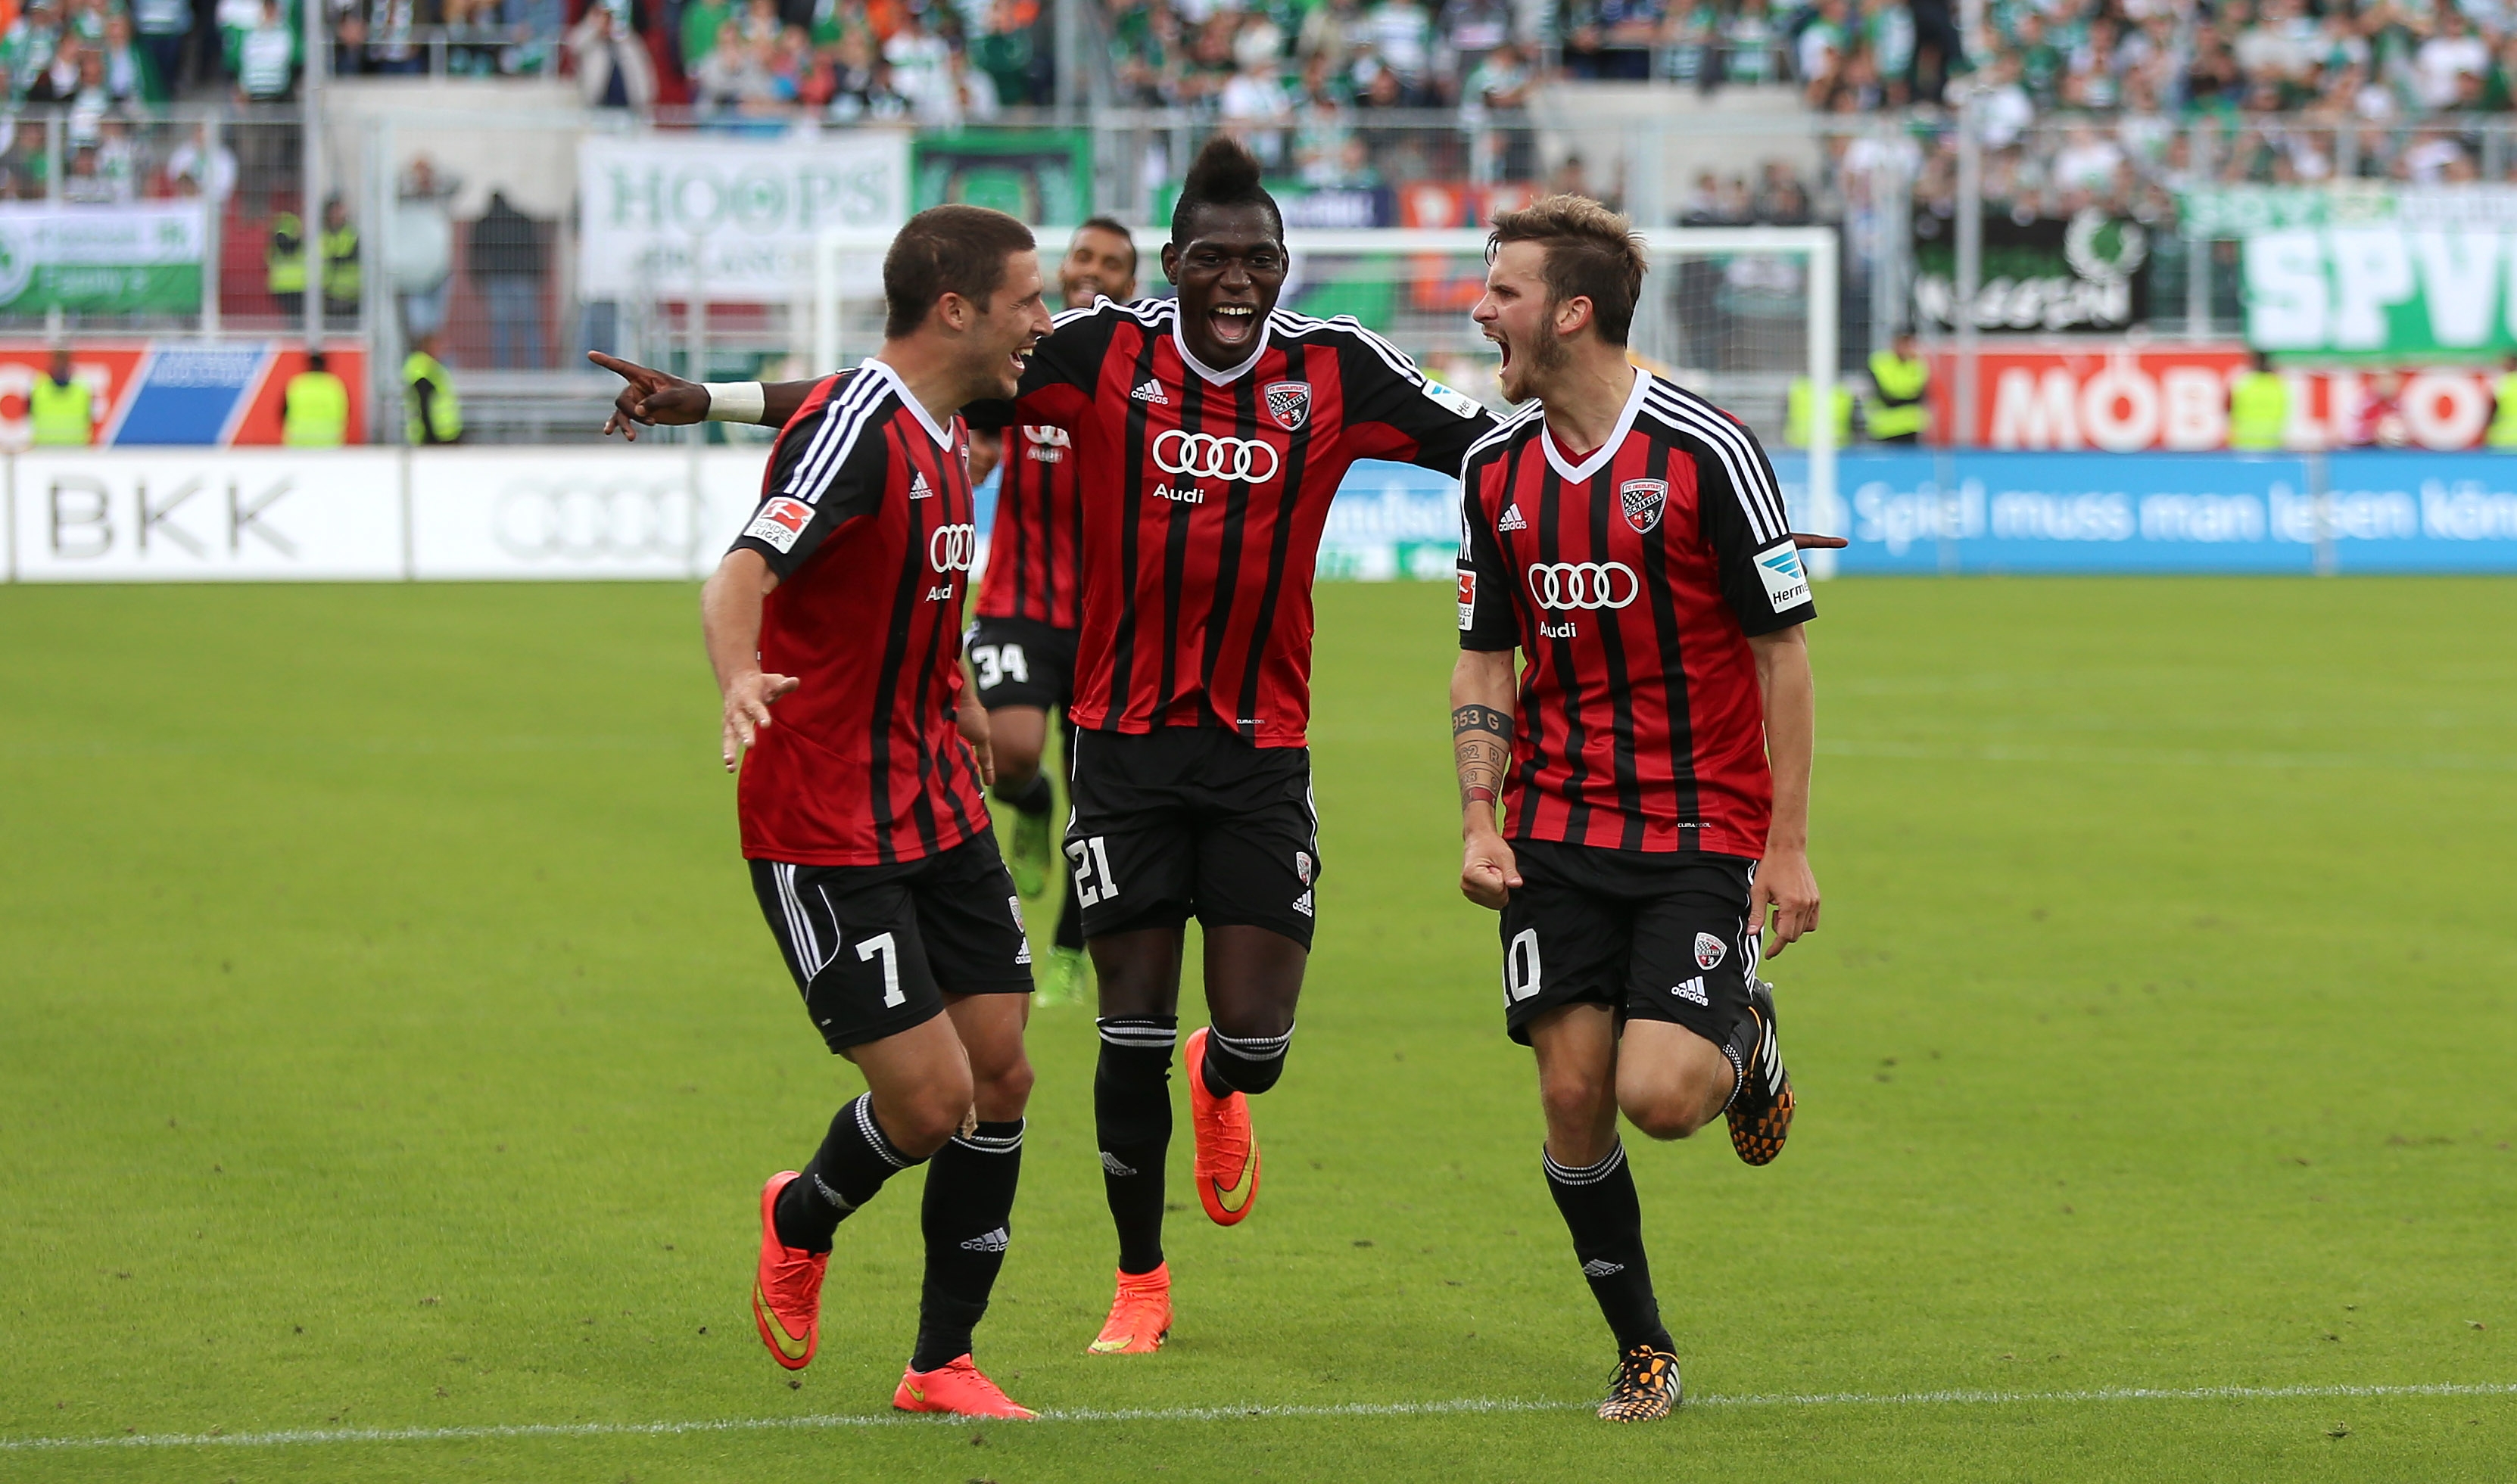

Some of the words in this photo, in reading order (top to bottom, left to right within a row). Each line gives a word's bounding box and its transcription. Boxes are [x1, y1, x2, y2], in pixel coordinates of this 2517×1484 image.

[610, 160, 892, 233] HOOPS
[1131, 388, 1169, 406] adidas
[1153, 483, 1204, 504] Audi
[48, 472, 301, 560] BKK
[1499, 520, 1527, 531] adidas
[1854, 478, 1986, 557] Spiel
[1991, 492, 2136, 543] muss
[2139, 493, 2266, 543] man
[2269, 480, 2417, 543] lesen
[752, 521, 793, 543] BUNDES
[754, 529, 780, 544] LIGA
[1540, 621, 1577, 638] Audi
[972, 644, 1029, 690] 34
[1489, 747, 1500, 766] R
[1065, 836, 1119, 909] 21
[855, 932, 907, 1009] 7
[1671, 985, 1709, 1006] adidas
